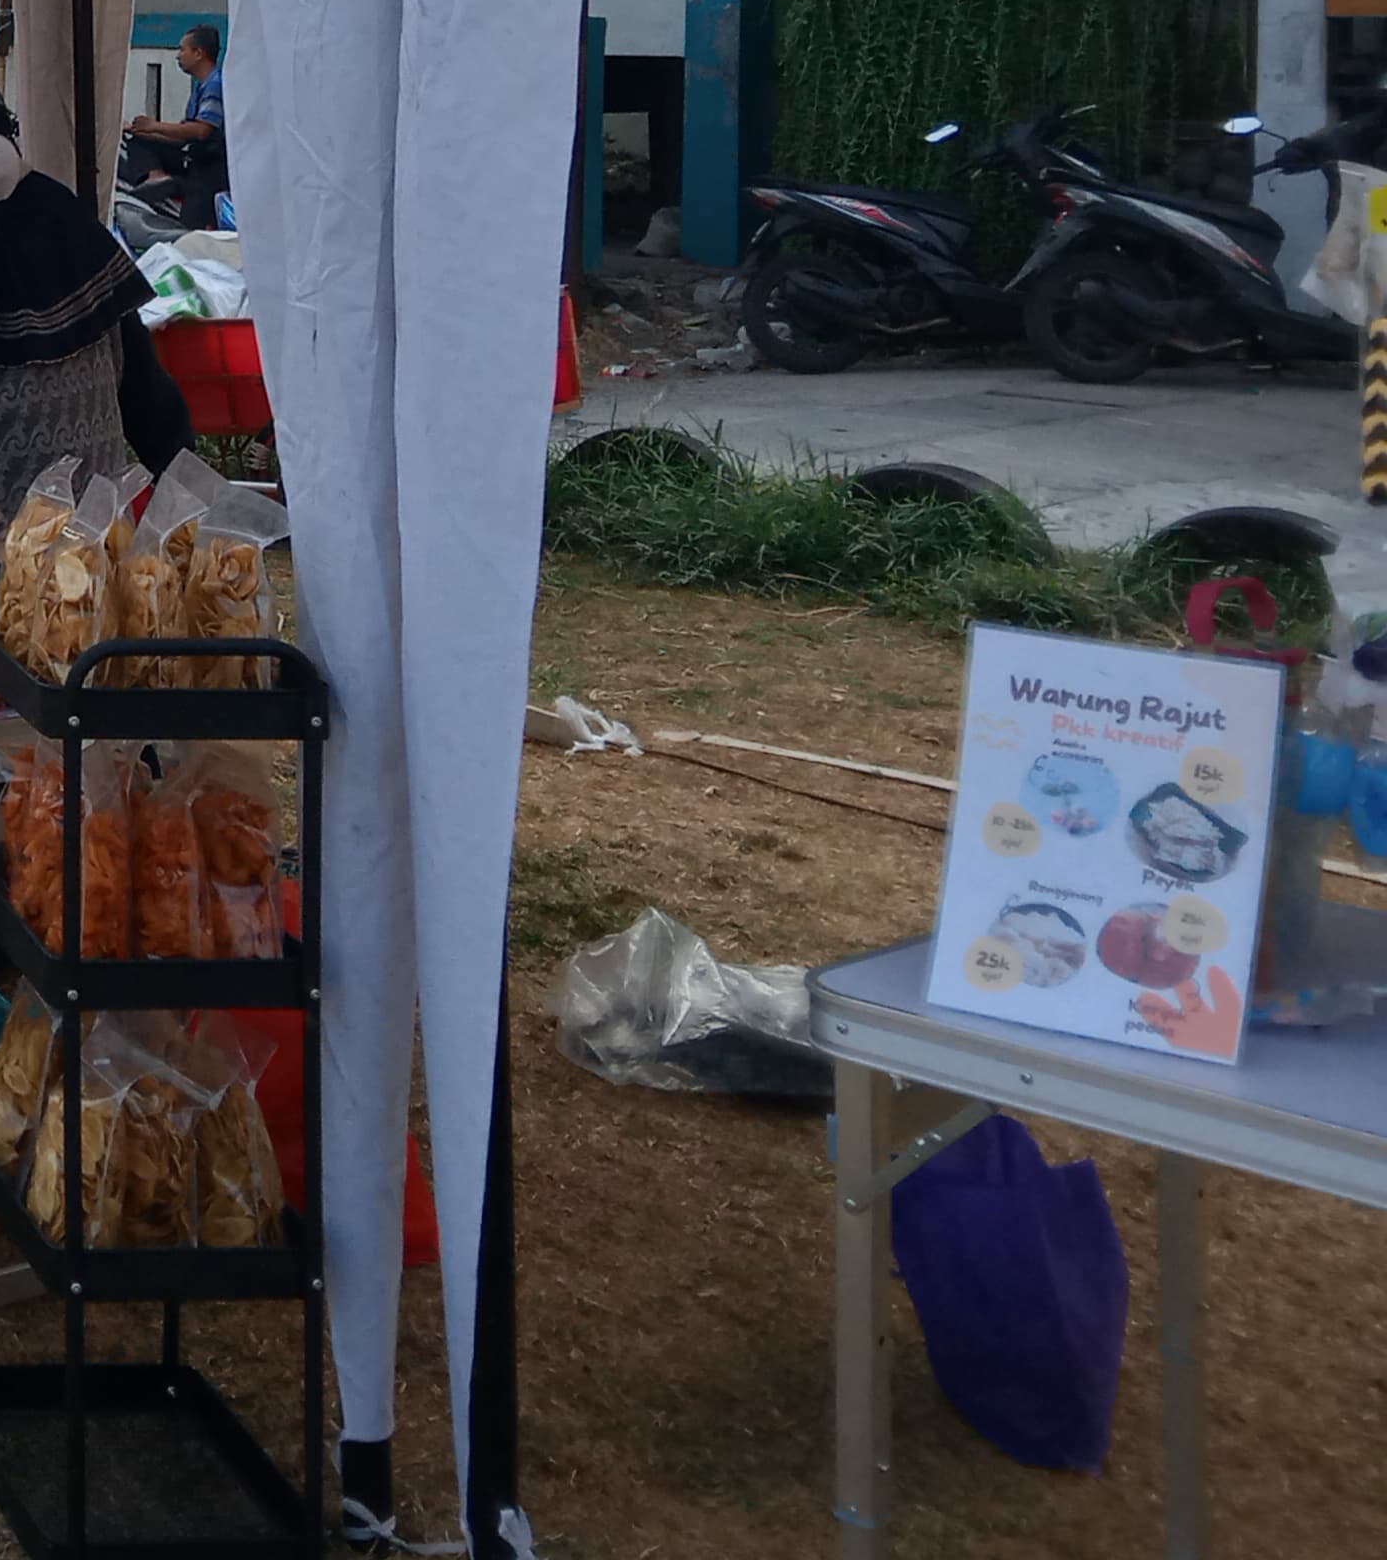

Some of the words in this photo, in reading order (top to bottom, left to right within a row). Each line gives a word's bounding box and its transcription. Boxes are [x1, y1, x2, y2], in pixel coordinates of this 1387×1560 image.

[1009, 675, 1131, 724] Warung
[1139, 695, 1228, 733] Rajut
[1193, 763, 1225, 783] 15k
[1142, 868, 1195, 893] Peyek
[975, 950, 1011, 972] 25k
